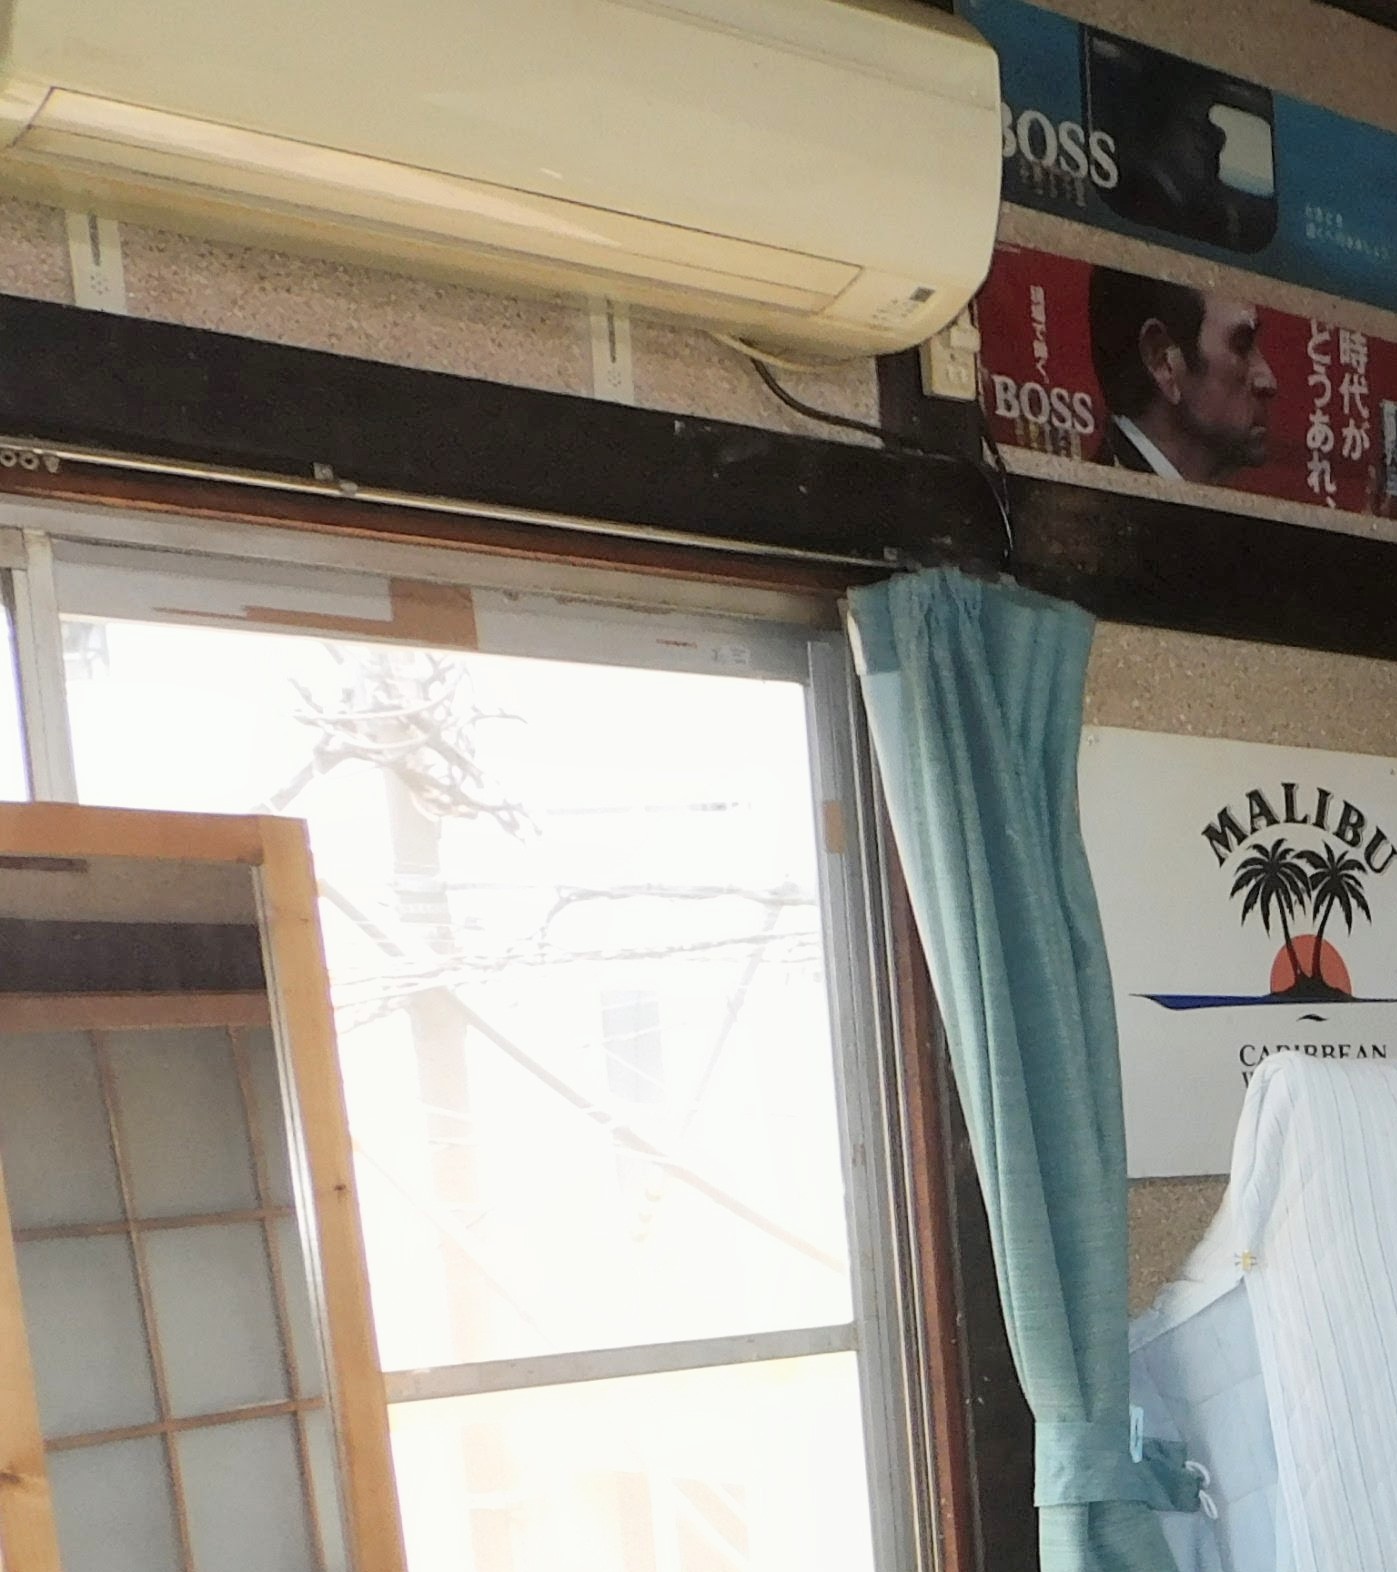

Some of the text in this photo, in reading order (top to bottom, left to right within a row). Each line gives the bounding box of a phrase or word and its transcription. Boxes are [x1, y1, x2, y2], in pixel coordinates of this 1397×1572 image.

[992, 374, 1095, 434] BOSS
[1339, 328, 1370, 461] 時代が
